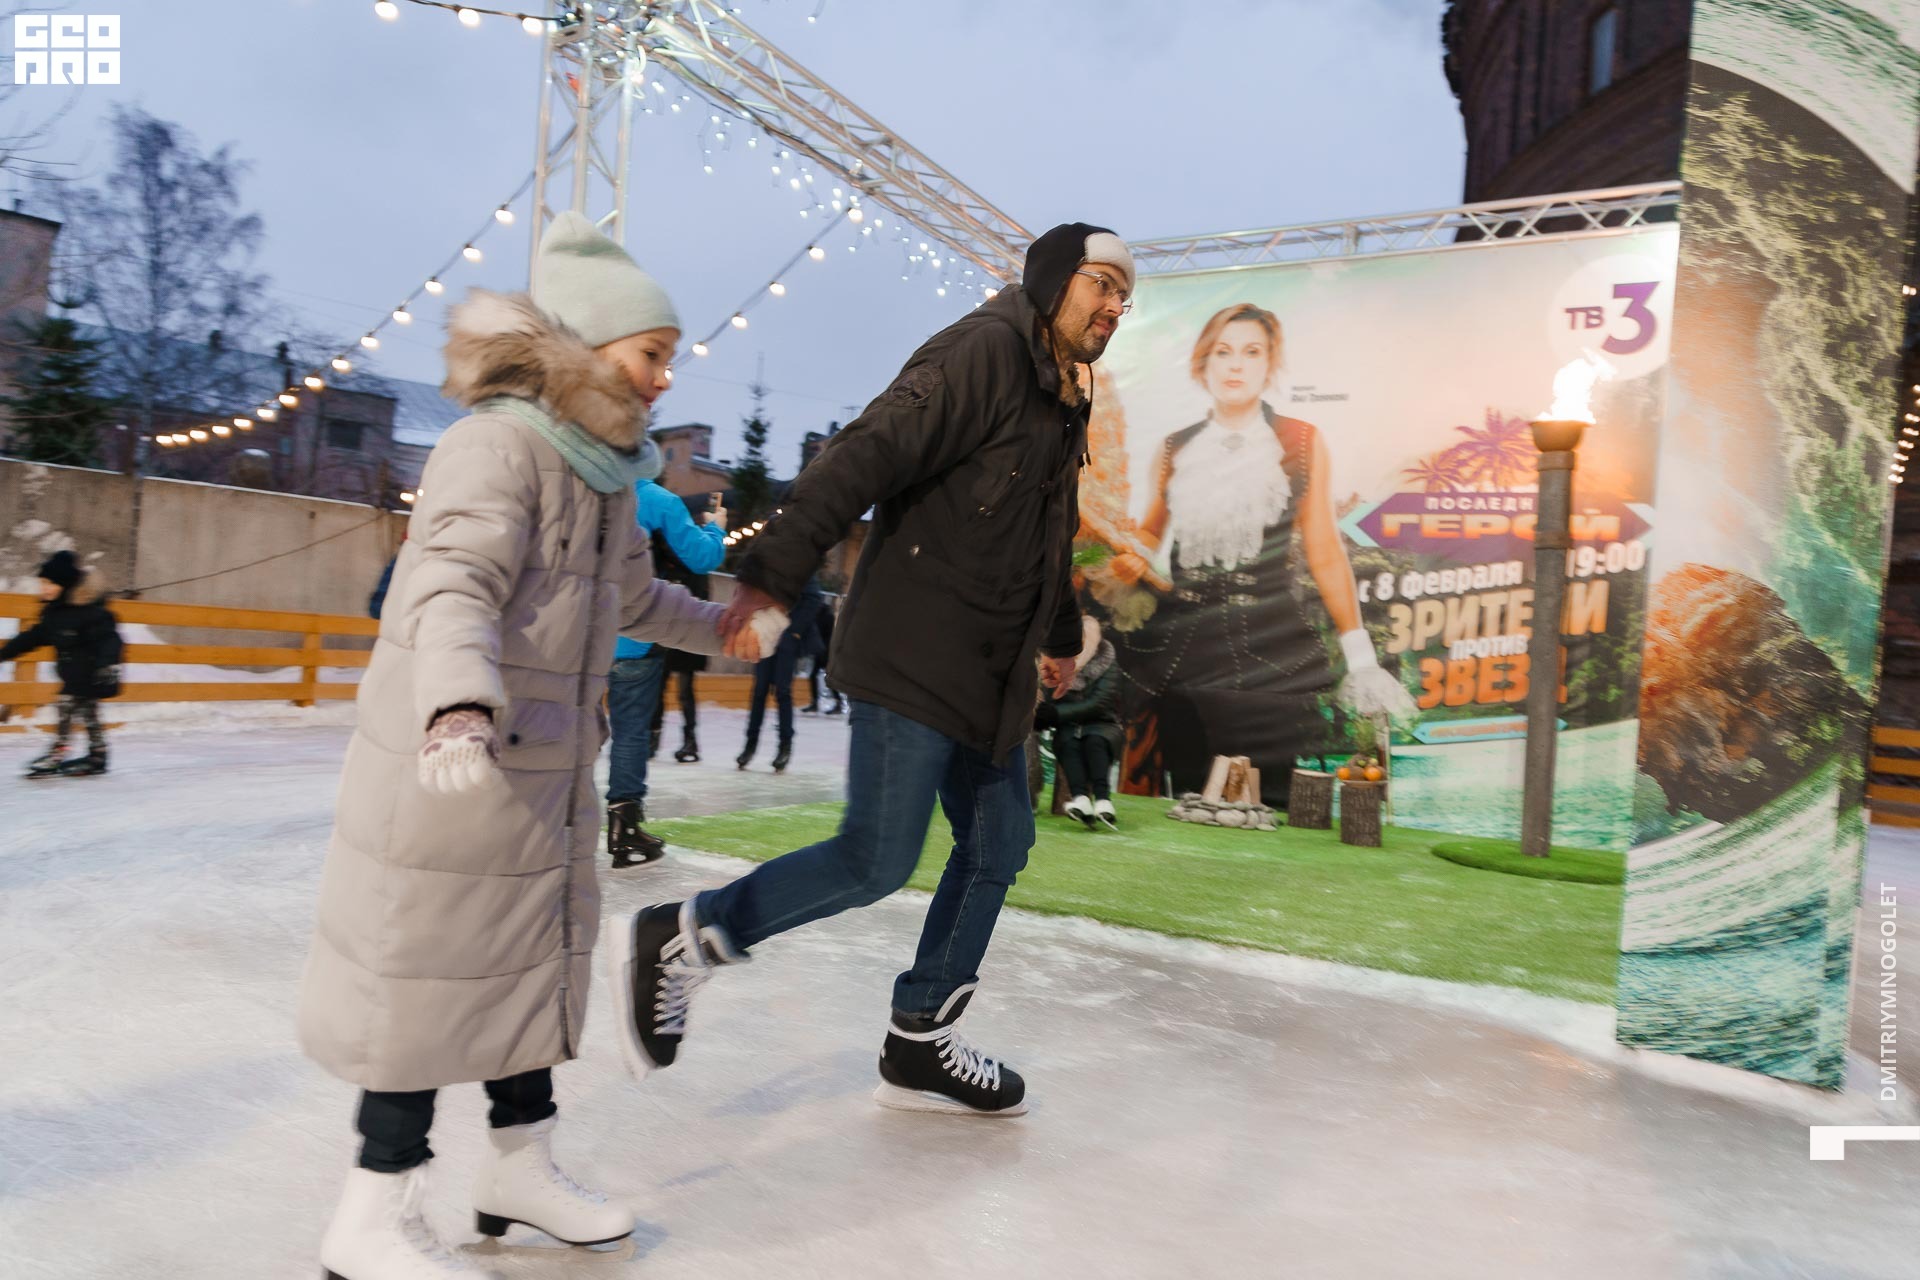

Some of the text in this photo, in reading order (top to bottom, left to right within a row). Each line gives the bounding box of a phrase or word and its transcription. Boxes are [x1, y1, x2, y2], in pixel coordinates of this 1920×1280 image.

[1425, 496, 1533, 512] ПОСЛЕДН
[1375, 572, 1395, 600] 8
[1401, 561, 1523, 600] февраля
[1386, 580, 1610, 654] ЗРИТЕИ
[1417, 646, 1568, 709] ЗВЕЗ
